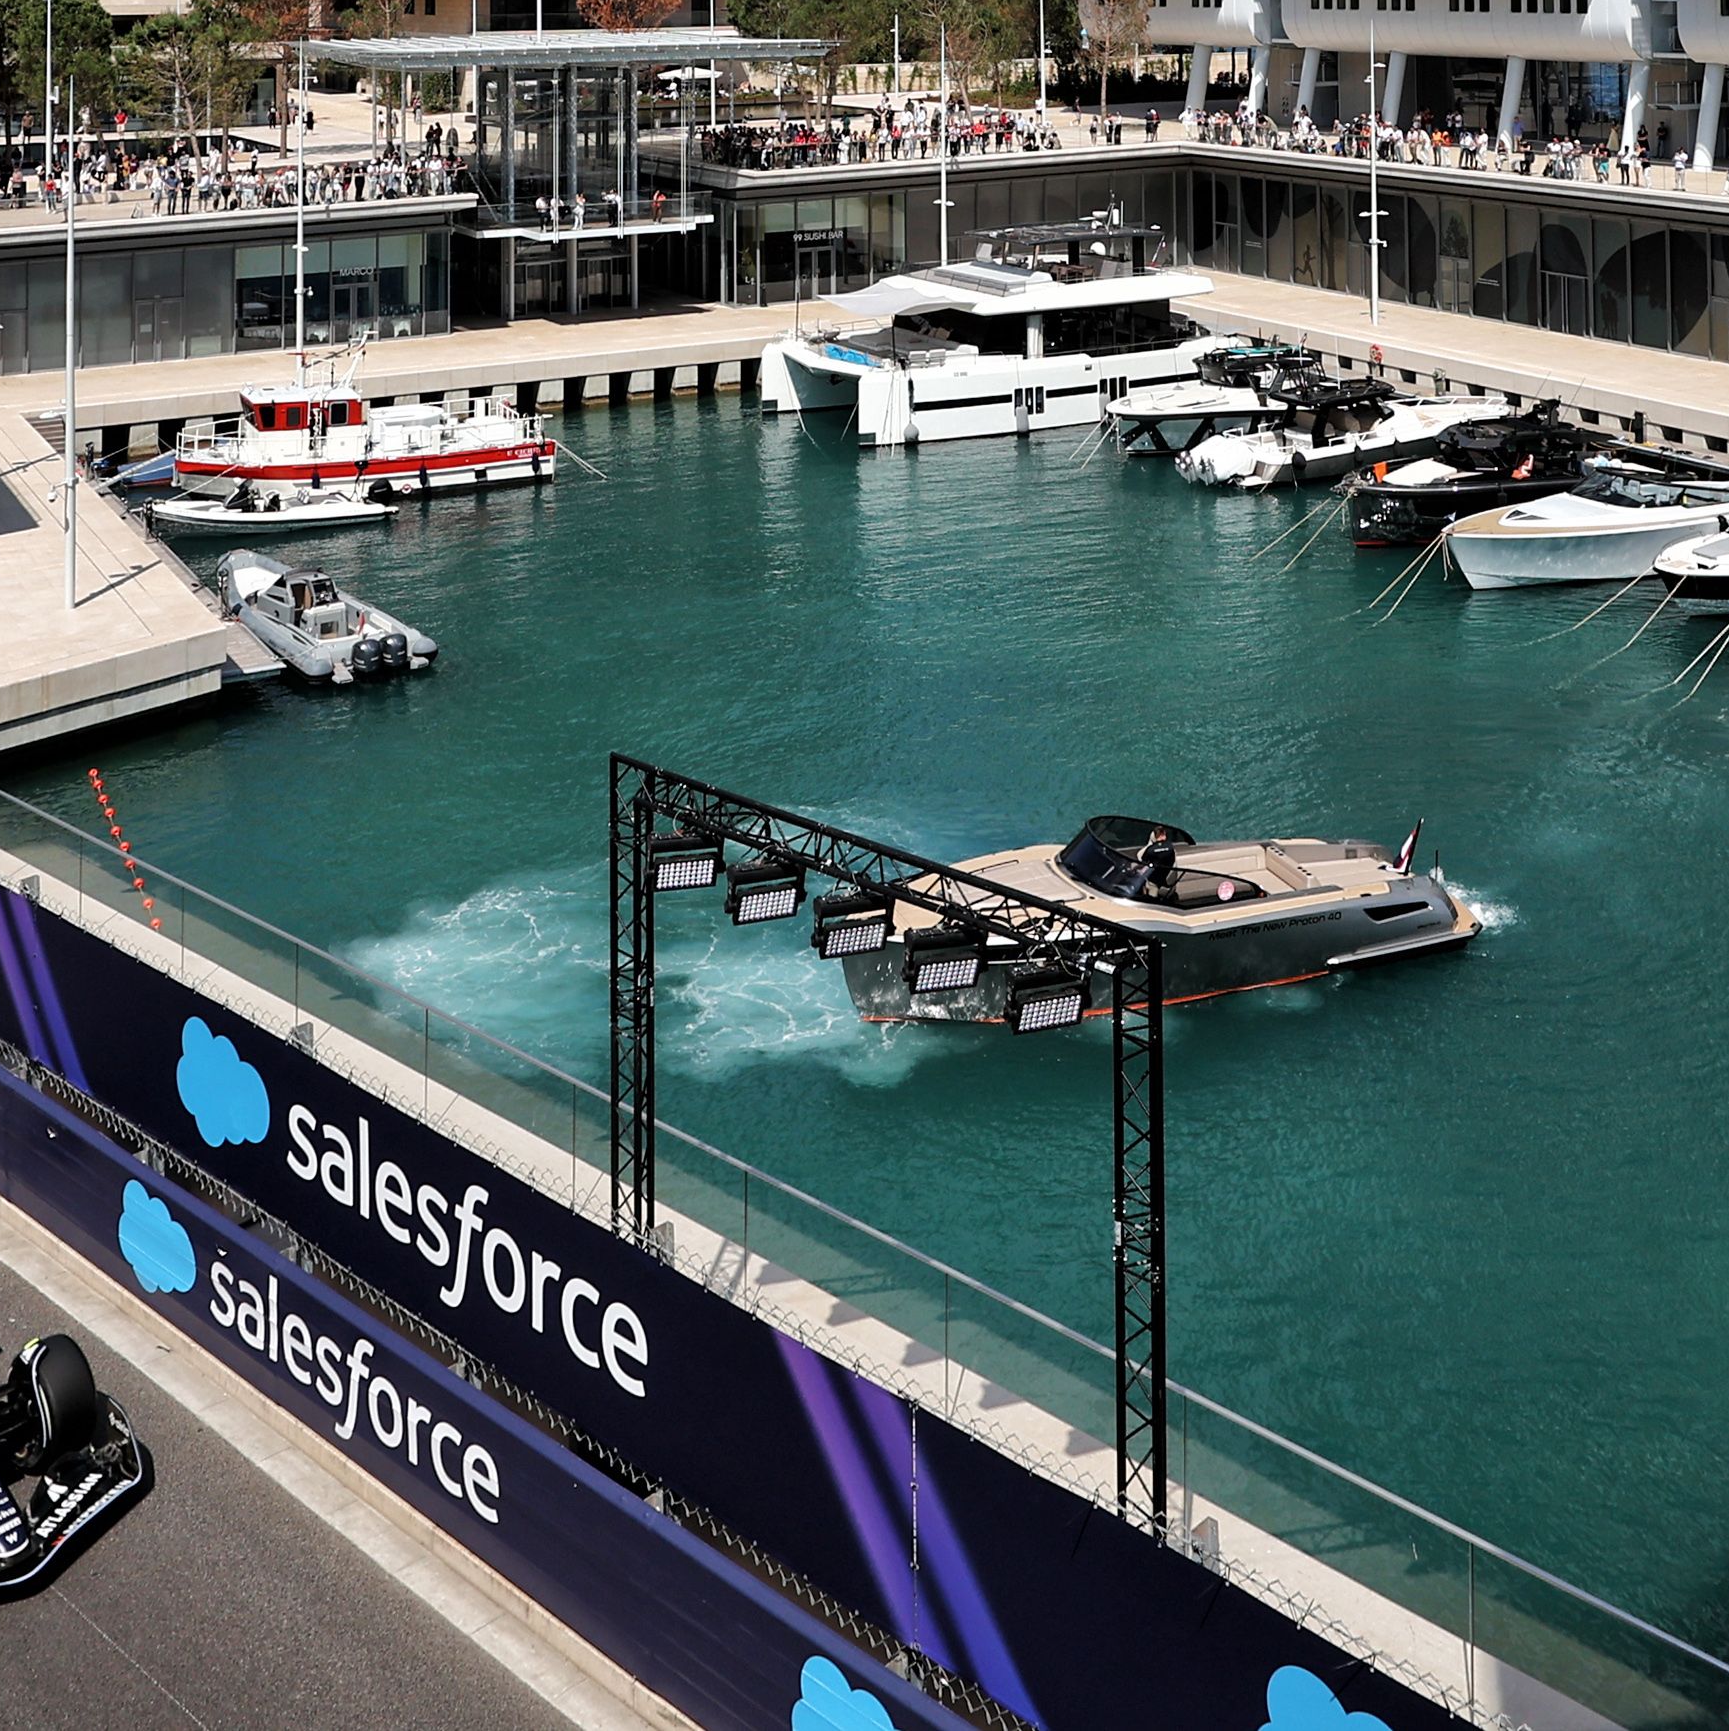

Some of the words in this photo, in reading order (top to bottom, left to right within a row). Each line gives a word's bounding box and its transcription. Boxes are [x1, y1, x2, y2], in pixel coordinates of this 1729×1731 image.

[793, 233, 803, 242] 99
[804, 232, 827, 241] SUSHI
[828, 230, 844, 239] BAR
[1208, 928, 1237, 941] Meet
[1240, 924, 1261, 936] The
[1263, 921, 1287, 932] New
[1288, 914, 1326, 927] Proton
[1328, 911, 1342, 922] 40
[286, 1104, 650, 1399] salesforce
[210, 1260, 501, 1524] salesforce
[36, 1473, 103, 1539] ATLASSIAN
